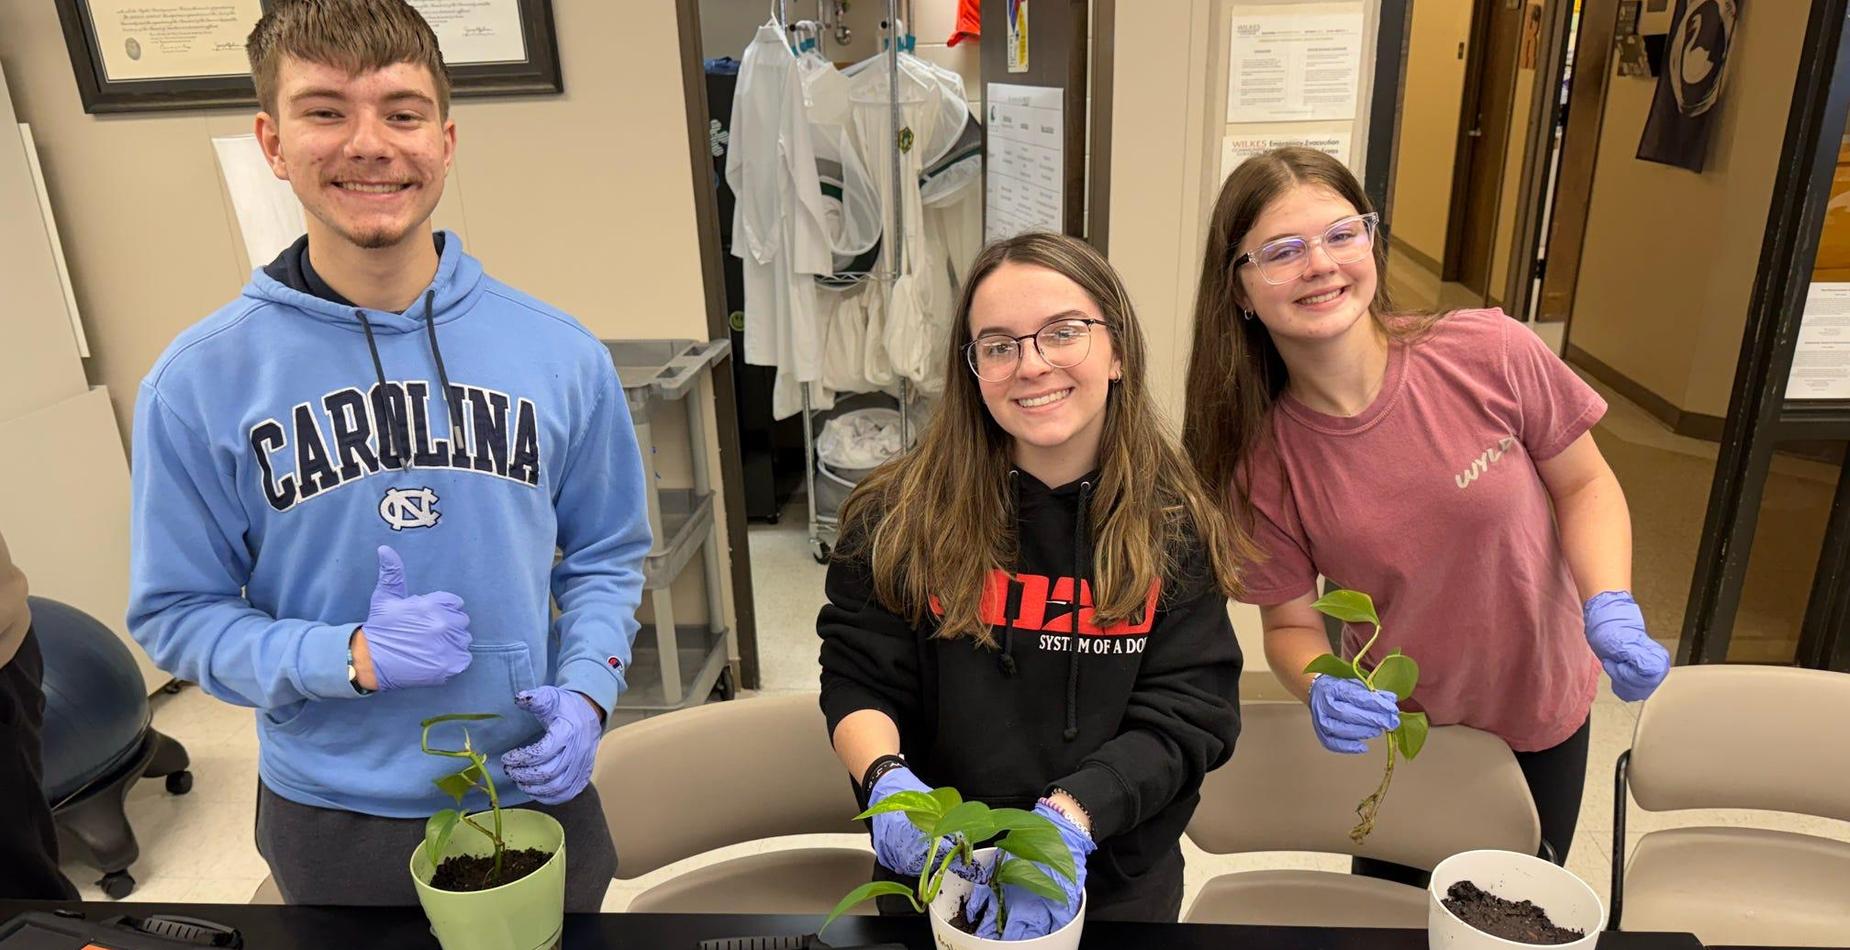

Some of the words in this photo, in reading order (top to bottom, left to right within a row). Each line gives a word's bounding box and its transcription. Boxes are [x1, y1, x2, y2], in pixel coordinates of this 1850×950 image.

[1232, 140, 1266, 148] WILKES
[1304, 138, 1340, 147] Evacuation
[250, 380, 540, 512] CAROLINA
[1093, 638, 1112, 654] OF
[1113, 638, 1123, 654] A
[1126, 636, 1148, 654] DO
